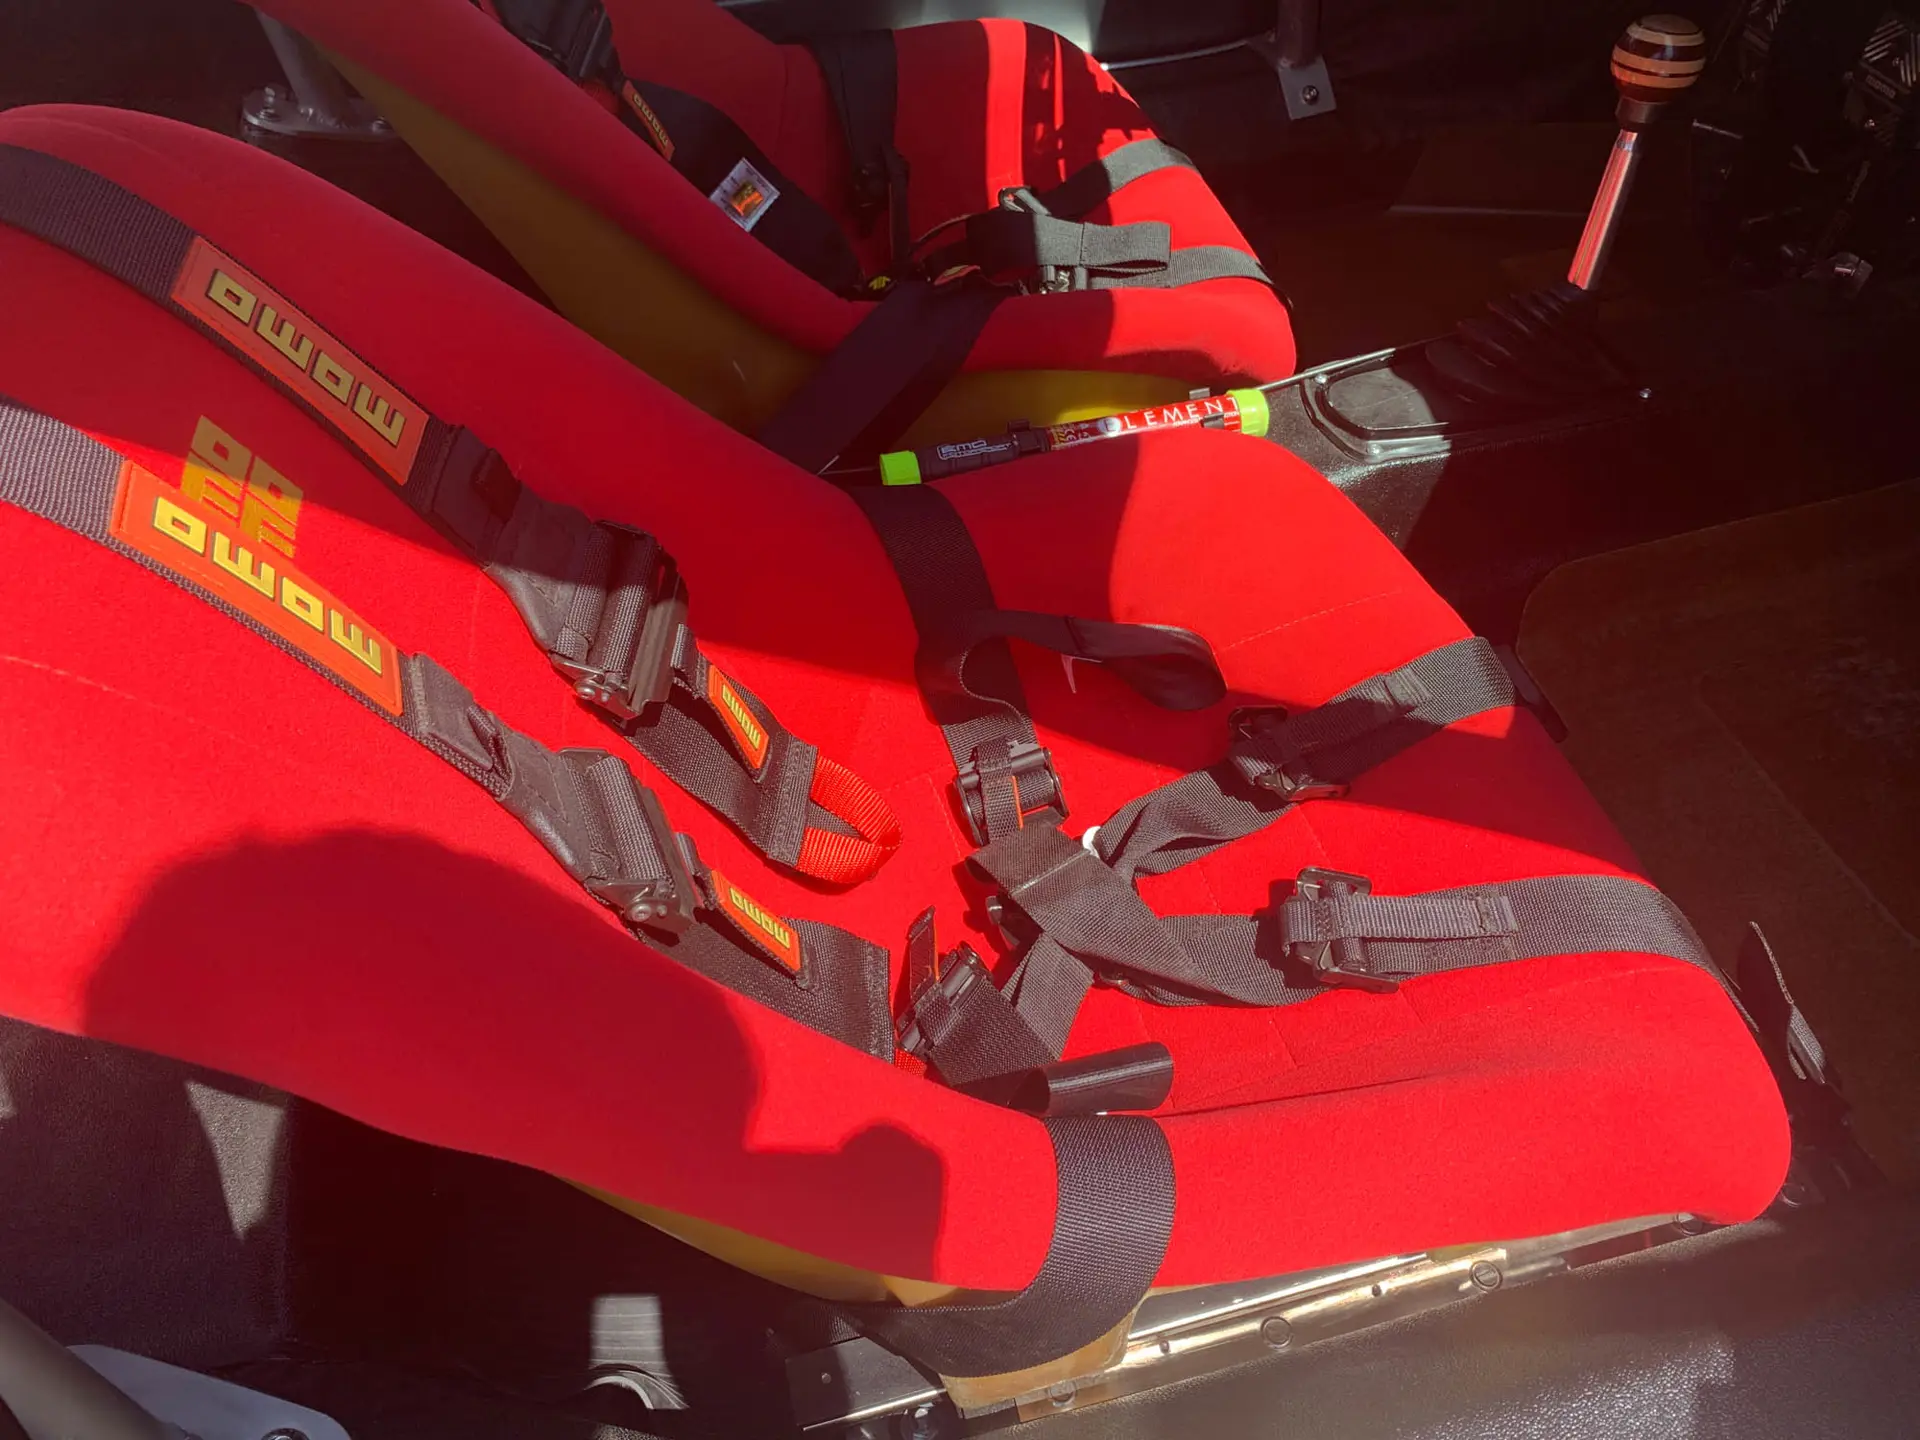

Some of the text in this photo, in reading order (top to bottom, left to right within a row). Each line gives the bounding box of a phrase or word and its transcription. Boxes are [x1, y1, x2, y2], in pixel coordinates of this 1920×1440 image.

[633, 94, 668, 148] MOMO
[207, 268, 406, 446] MOMO
[152, 496, 383, 676] MOMO
[721, 683, 761, 751] MOMO
[729, 887, 791, 949] MOMO
